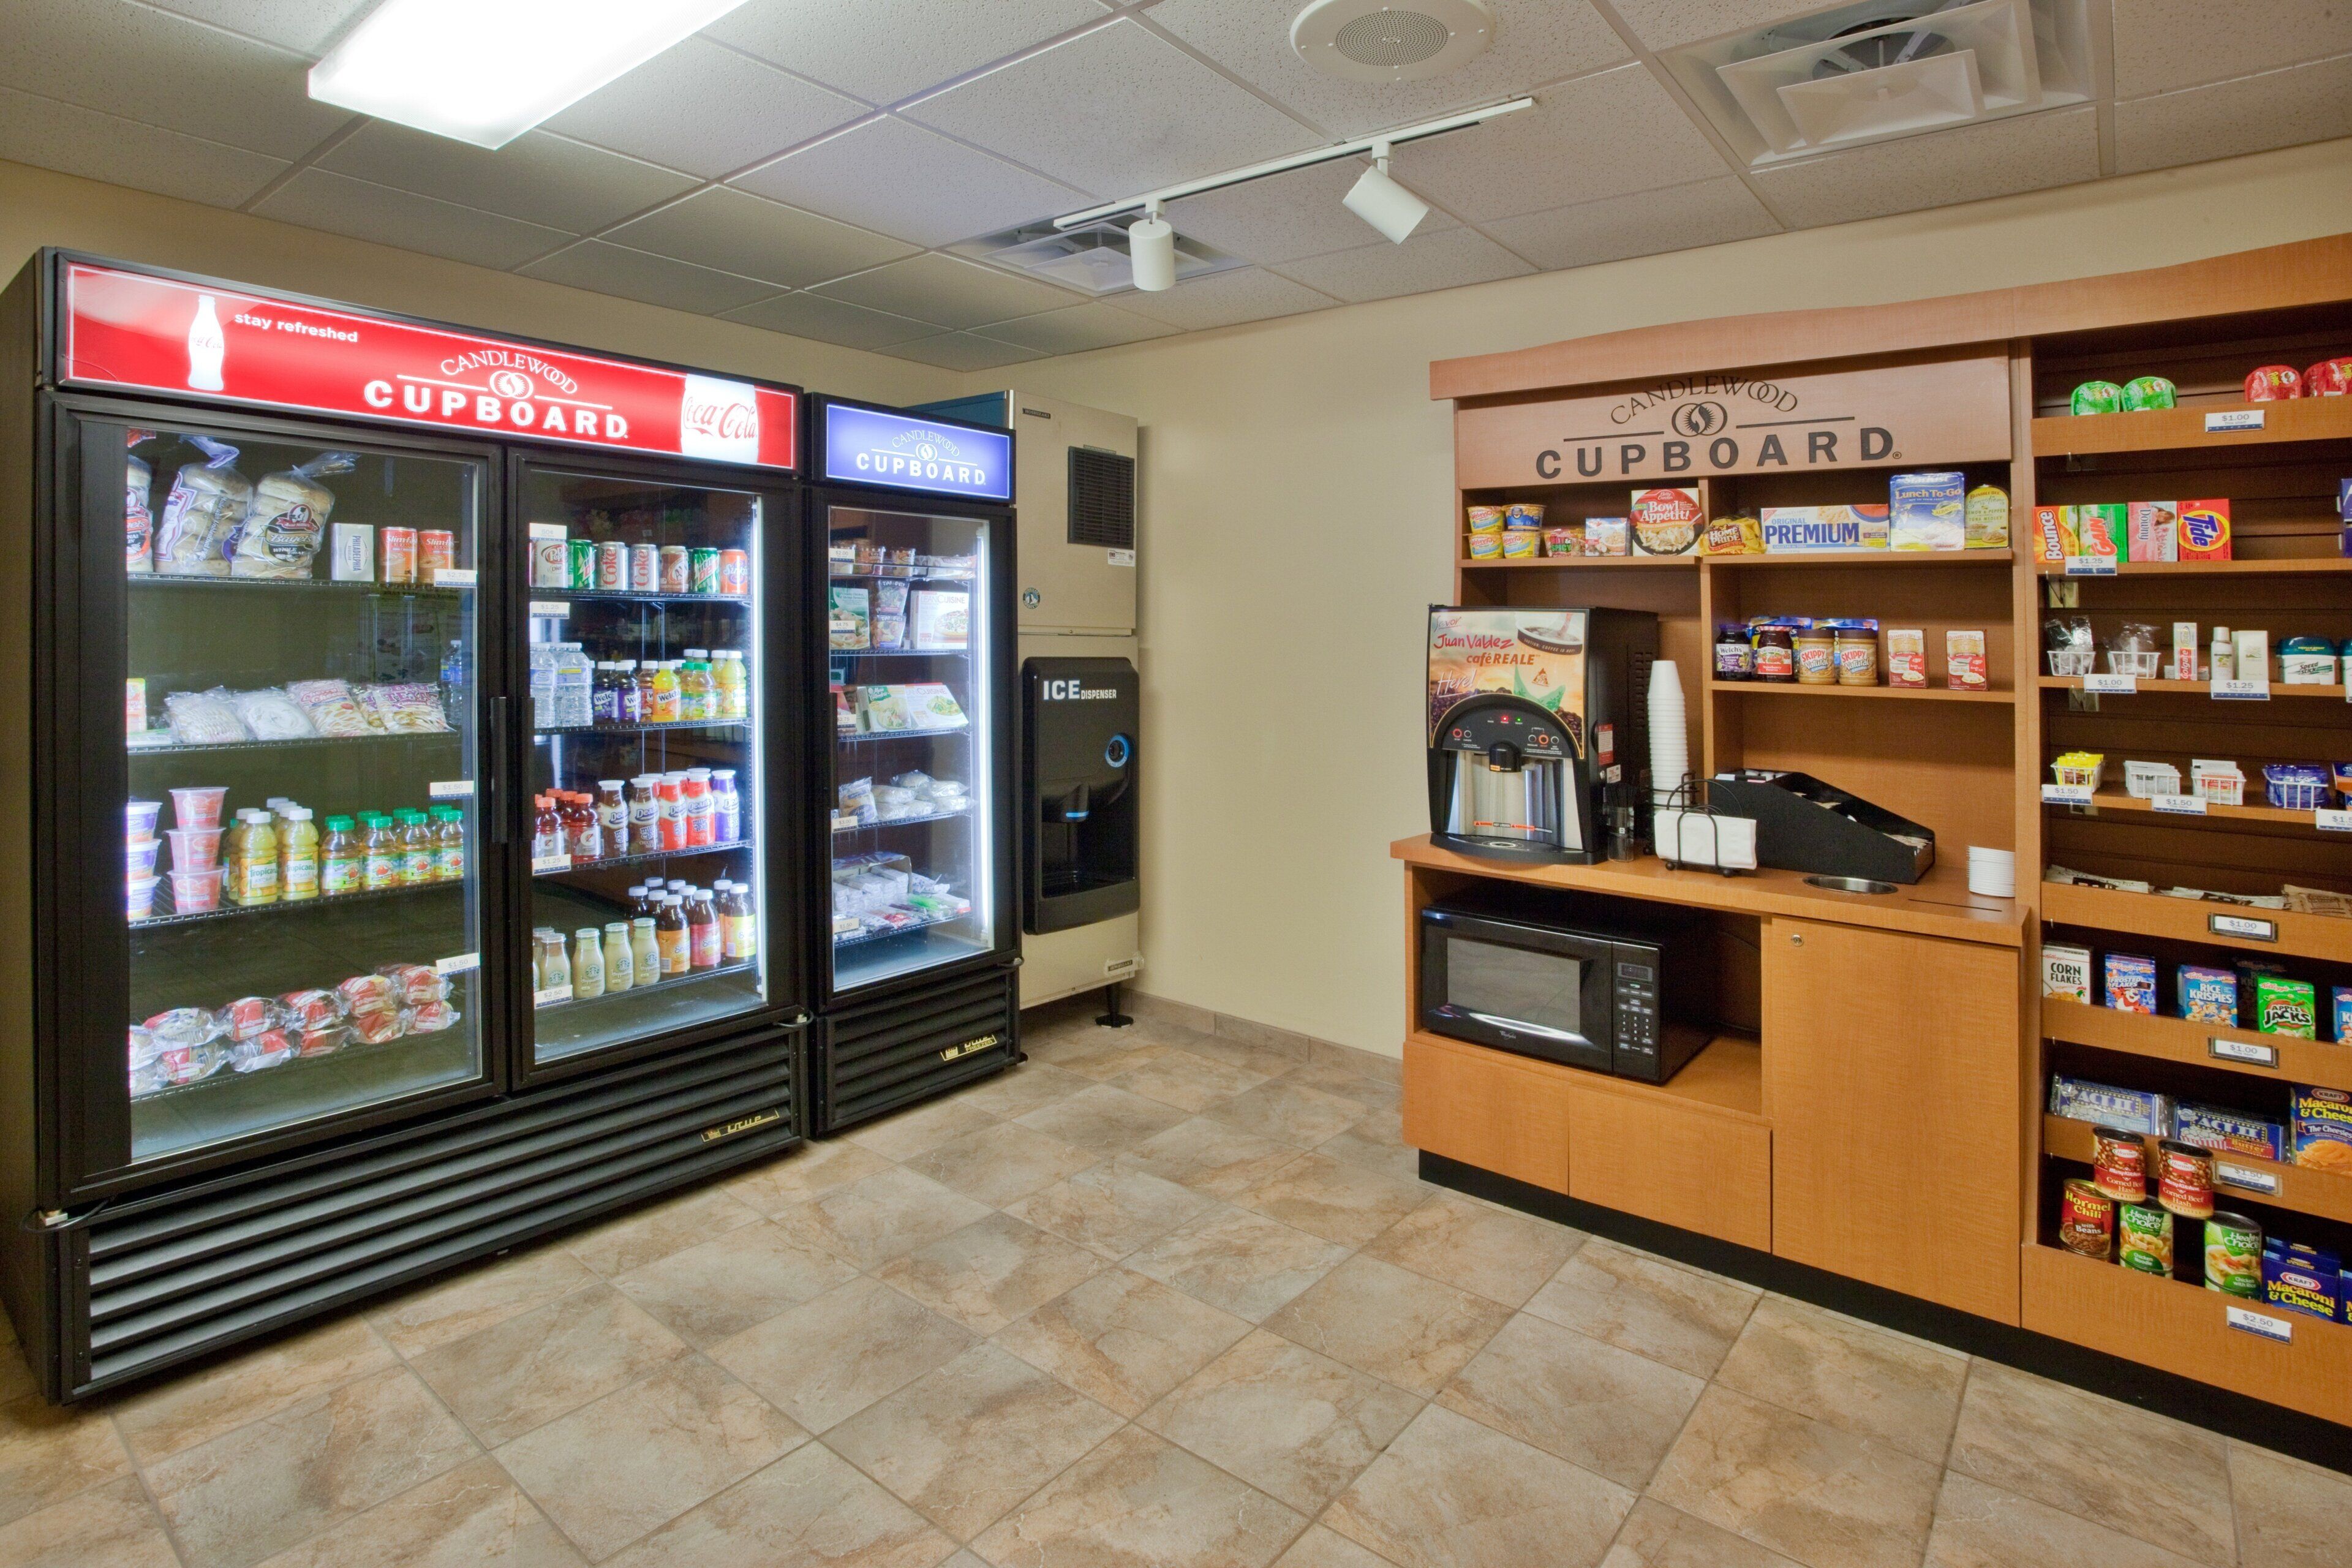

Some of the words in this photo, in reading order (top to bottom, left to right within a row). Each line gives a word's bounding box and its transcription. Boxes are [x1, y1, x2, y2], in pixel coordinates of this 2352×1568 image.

[235, 314, 272, 330] stay
[277, 320, 358, 342] refreshed
[440, 350, 578, 395] CANDLEWOOD
[1611, 375, 1798, 425] CANDLEWOOD
[364, 380, 629, 439] CUPBOARD
[683, 396, 758, 440] Coca-Cola
[892, 430, 960, 457] CANDLEWOOD
[1536, 427, 1894, 480] CUPBOARD
[856, 453, 986, 486] CUPBOARD
[1895, 490, 1927, 500] Lunch
[1929, 488, 1961, 497] To-Go
[1648, 500, 1679, 512] Bowl
[1471, 510, 1493, 519] Velveeta
[1641, 509, 1689, 523] Appétit!
[2138, 508, 2152, 541] Downy
[2180, 513, 2220, 548] Tide
[270, 533, 313, 545] Bagels
[1709, 527, 1738, 538] HOME
[1711, 534, 1740, 545] PRIDE
[1765, 522, 1860, 545] PREMIUM
[2041, 510, 2064, 560] Bounce
[1471, 537, 1493, 546] Velveeta
[352, 535, 361, 571] PHILADELPHIA
[602, 548, 617, 585] Coke
[634, 550, 649, 586] Coke
[938, 595, 965, 604] CUISINE
[1433, 635, 1464, 649] Juan
[1466, 635, 1515, 649] Valdez
[1801, 649, 1826, 661] SKIPPY
[1841, 650, 1866, 661] SKIPPY
[1805, 657, 1828, 669] Natural
[1845, 657, 1869, 669] Natural
[2180, 649, 2190, 680] Colgate
[1438, 669, 1476, 690] Here!
[1043, 680, 1080, 700] ICE
[1080, 689, 1117, 699] DISPENSER
[2332, 815, 2352, 824] $1.5
[286, 862, 315, 872] Tropicana
[2229, 920, 2258, 929] $1.00
[447, 959, 469, 969] $1.50
[2051, 962, 2081, 976] CORN
[2109, 962, 2134, 971] Kellogg's
[2051, 973, 2082, 986] FLAKES
[2184, 972, 2215, 982] Kellogg's
[543, 989, 563, 998] $2.50
[2199, 983, 2221, 993] RICE
[2260, 982, 2290, 992] Kellogg's
[2189, 989, 2233, 1004] KRISPIES
[2271, 1004, 2300, 1012] APPLE
[2264, 1009, 2311, 1028] JACKS
[965, 1039, 993, 1052] FREEZER
[2230, 1044, 2258, 1054] $1.00
[2077, 1091, 2111, 1109] ACT
[2112, 1096, 2133, 1112] II
[2319, 1091, 2343, 1100] KRAFT
[2299, 1098, 2352, 1114] Macaro
[2300, 1108, 2310, 1117] &
[2312, 1107, 2352, 1125] Chees
[2198, 1118, 2235, 1133] ACT
[2237, 1125, 2259, 1139] II
[2308, 1124, 2323, 1133] The
[2323, 1125, 2352, 1139] Cheesies
[2231, 1137, 2265, 1153] Butter
[2234, 1169, 2263, 1179] $1.50
[2106, 1177, 2132, 1187] Corned
[2118, 1185, 2136, 1194] Hash
[2162, 1186, 2187, 1200] Corned
[2065, 1190, 2111, 1212] Hormel
[2173, 1197, 2192, 1208] Hash
[2073, 1204, 2102, 1219] Chili
[2129, 1209, 2164, 1224] Healthy
[2075, 1223, 2101, 1234] Beans
[2125, 1214, 2162, 1229] Choice
[2133, 1251, 2154, 1261] Chicken
[2134, 1256, 2153, 1266] Noodle
[2288, 1276, 2313, 1286] KRAFT
[2267, 1280, 2335, 1308] Macaroni
[2269, 1291, 2279, 1301] &
[2281, 1292, 2334, 1317] Cheese
[2242, 1313, 2274, 1328] $2.50
